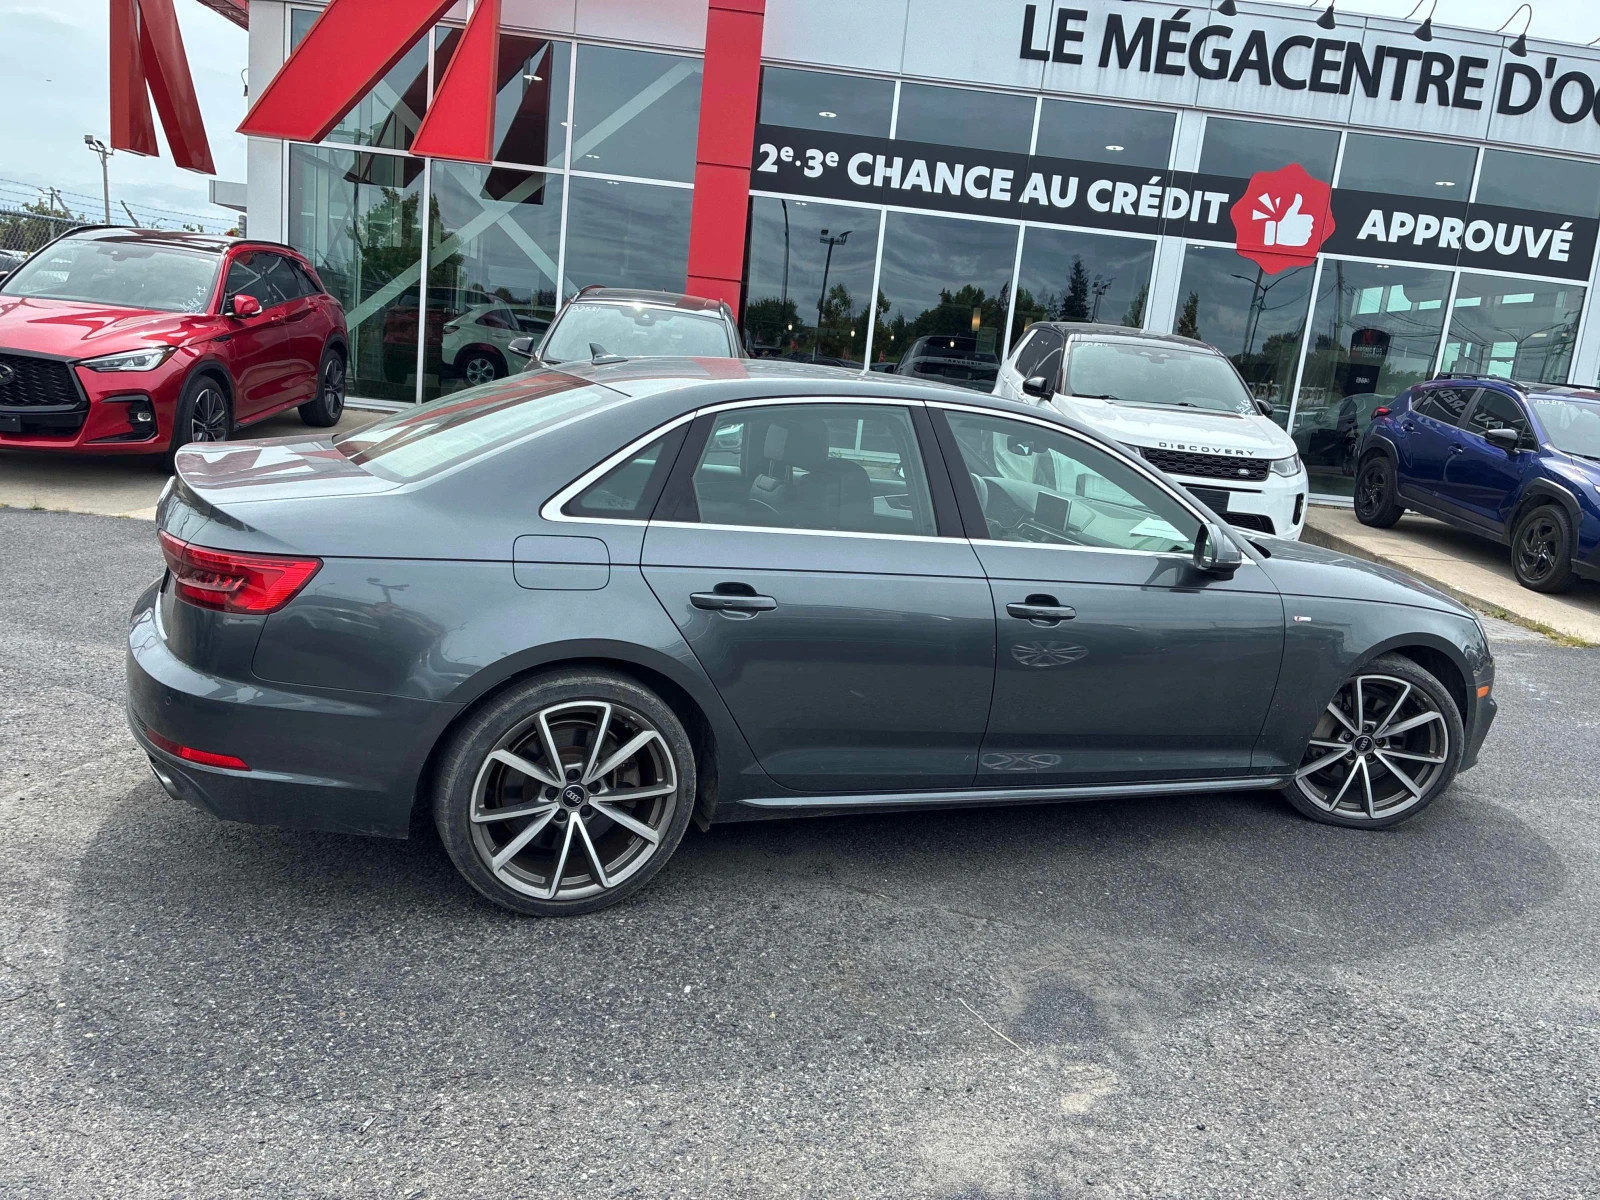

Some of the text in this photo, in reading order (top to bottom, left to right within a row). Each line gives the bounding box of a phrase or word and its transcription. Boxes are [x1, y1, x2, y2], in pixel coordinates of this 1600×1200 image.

[1020, 4, 1600, 128] LE MÉGACENTRE D'O
[847, 152, 1014, 202] CHANCE
[1018, 172, 1079, 208] AU
[1086, 176, 1229, 224] CRÉDIT
[1356, 209, 1574, 262] APPROUVÉ
[1158, 441, 1255, 456] DISCOVERY
